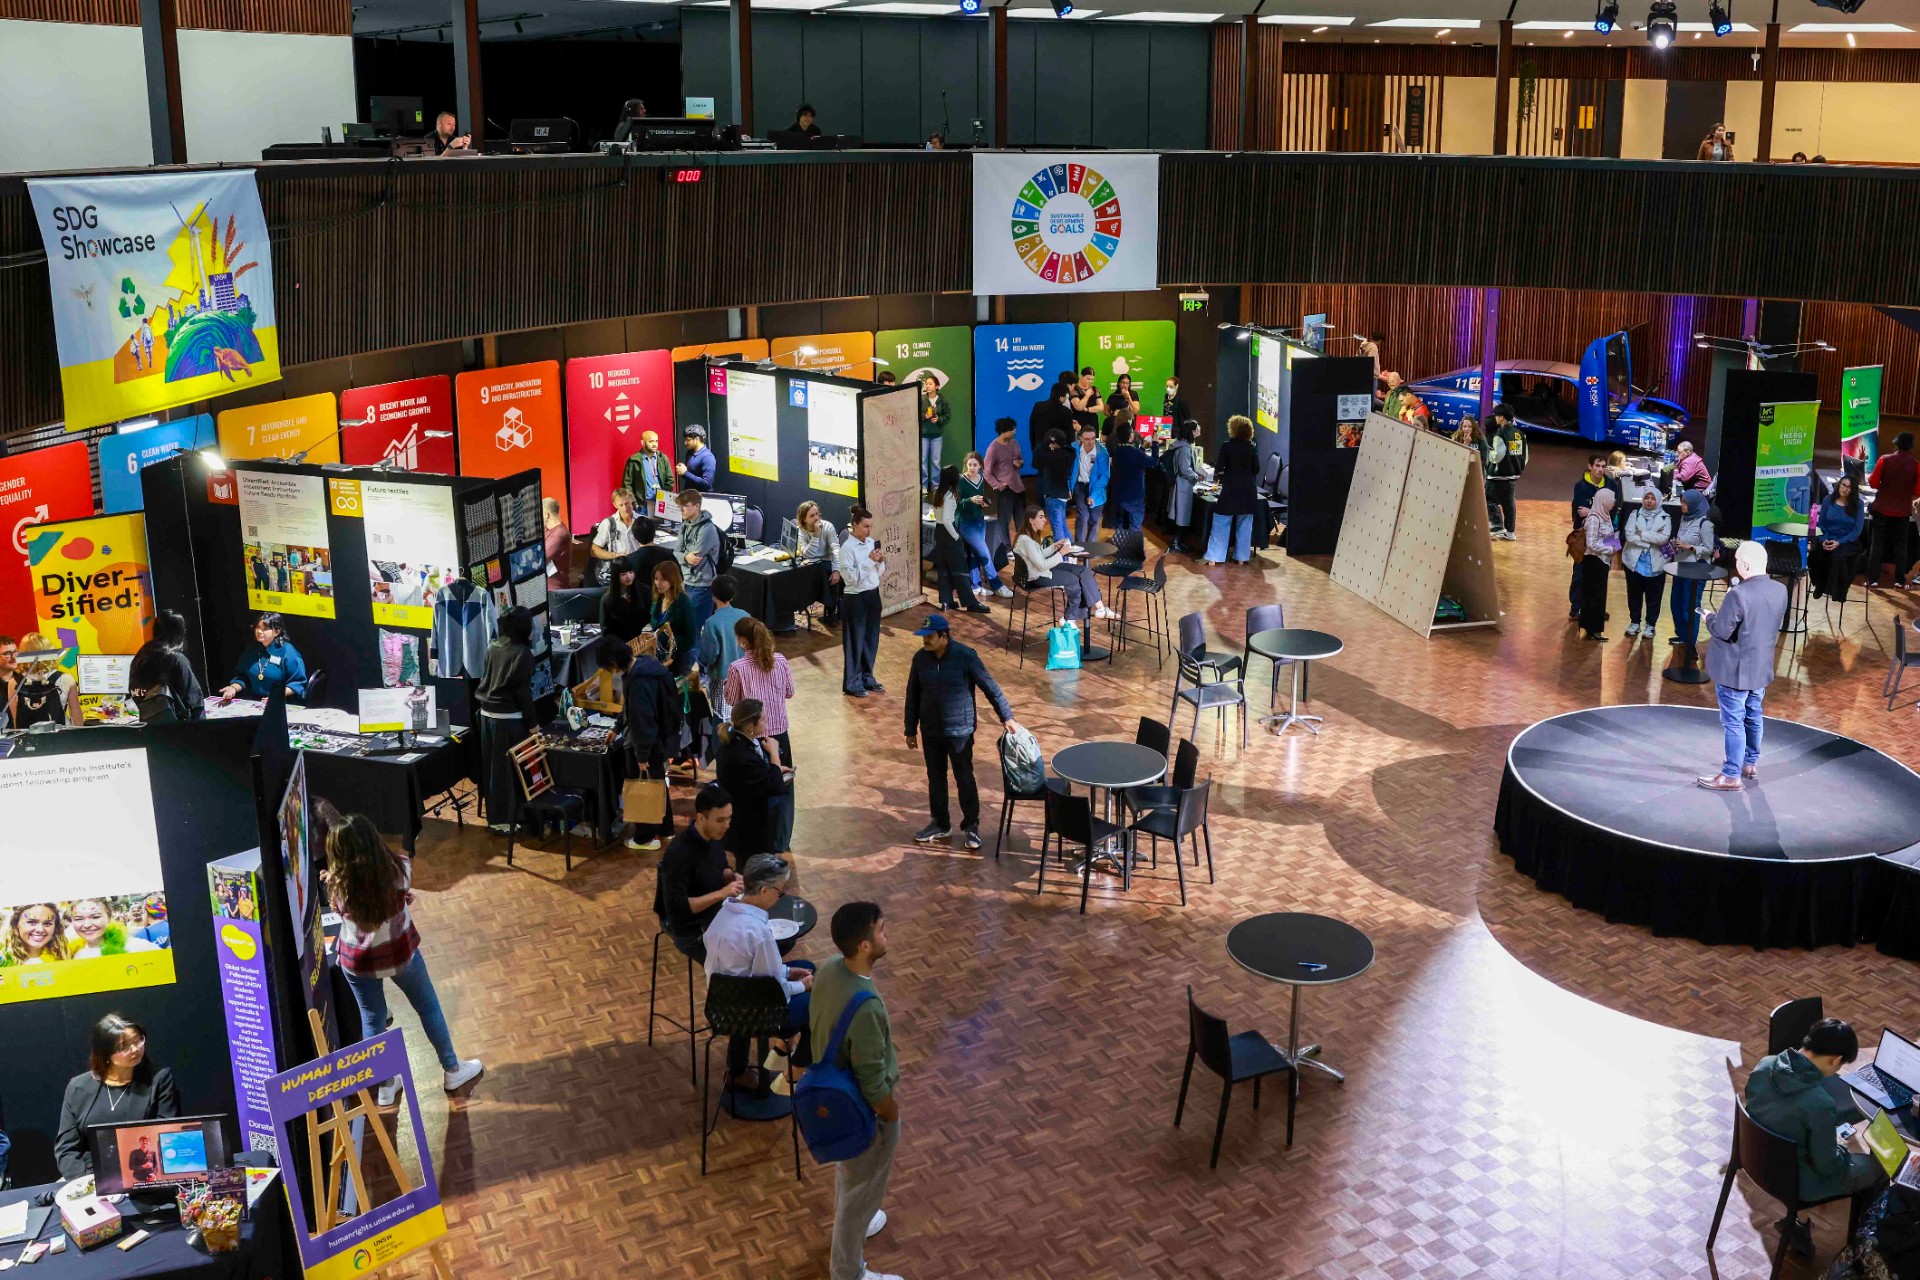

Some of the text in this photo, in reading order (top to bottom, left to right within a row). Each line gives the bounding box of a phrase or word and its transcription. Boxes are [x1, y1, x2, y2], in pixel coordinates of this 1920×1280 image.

[52, 205, 98, 232] SDG
[1050, 224, 1085, 234] GOALS
[61, 234, 156, 260] Showcase
[912, 341, 932, 350] CLIMATE
[995, 337, 1009, 353] 14
[1098, 335, 1112, 350] 15
[896, 343, 910, 359] 13
[912, 350, 930, 358] ACTION
[792, 350, 807, 367] 12
[810, 355, 846, 365] CONSUMPTION
[607, 368, 631, 377] REDUCED
[515, 378, 542, 389] INNOVATION
[588, 371, 604, 389] 10
[607, 377, 641, 388] INEQUALITIES
[1455, 378, 1468, 389] 11
[480, 386, 490, 405] 9
[491, 388, 543, 403] AND INFRASTRUCTURE
[1591, 386, 1599, 407] UNSW
[380, 396, 428, 411] DECENT WORK AND
[366, 405, 376, 424] 8
[380, 406, 431, 422] ECONOMIC GROWTH
[261, 415, 308, 432] AFFORDABLE AND
[246, 425, 255, 446] 7
[262, 429, 301, 444] CLEAN ENERGY
[1783, 438, 1803, 446] UNSW
[141, 441, 180, 459] CLEAN WATER
[127, 452, 138, 475] 6
[0, 477, 26, 491] GENDER
[0, 489, 33, 506] EQUALITY
[387, 487, 409, 496] textiles
[50, 588, 140, 620] sified:
[25, 767, 57, 777] Human
[59, 765, 87, 775] Rights
[89, 761, 132, 771] Institute's
[25, 776, 71, 787] fellowship
[72, 773, 109, 784] program
[224, 963, 260, 975] Global Student
[229, 970, 258, 982] Fellowships
[226, 978, 262, 989] provide UNSW
[233, 986, 255, 995] students
[228, 999, 260, 1010] opportunities
[235, 1006, 255, 1016] Australia
[231, 1039, 251, 1049] Without
[238, 1034, 263, 1044] Engineers
[246, 1048, 268, 1059] Migration
[235, 1060, 248, 1068] Food
[247, 1063, 268, 1072] Program
[255, 1057, 270, 1066] World
[281, 1041, 387, 1093] HUMAN RIGHTS
[239, 1067, 250, 1076] help
[241, 1075, 254, 1083] their
[307, 1067, 375, 1103] DEFENDER
[328, 1202, 415, 1249] humanrights.unsw.edu.au
[373, 1233, 393, 1247] UNSW
